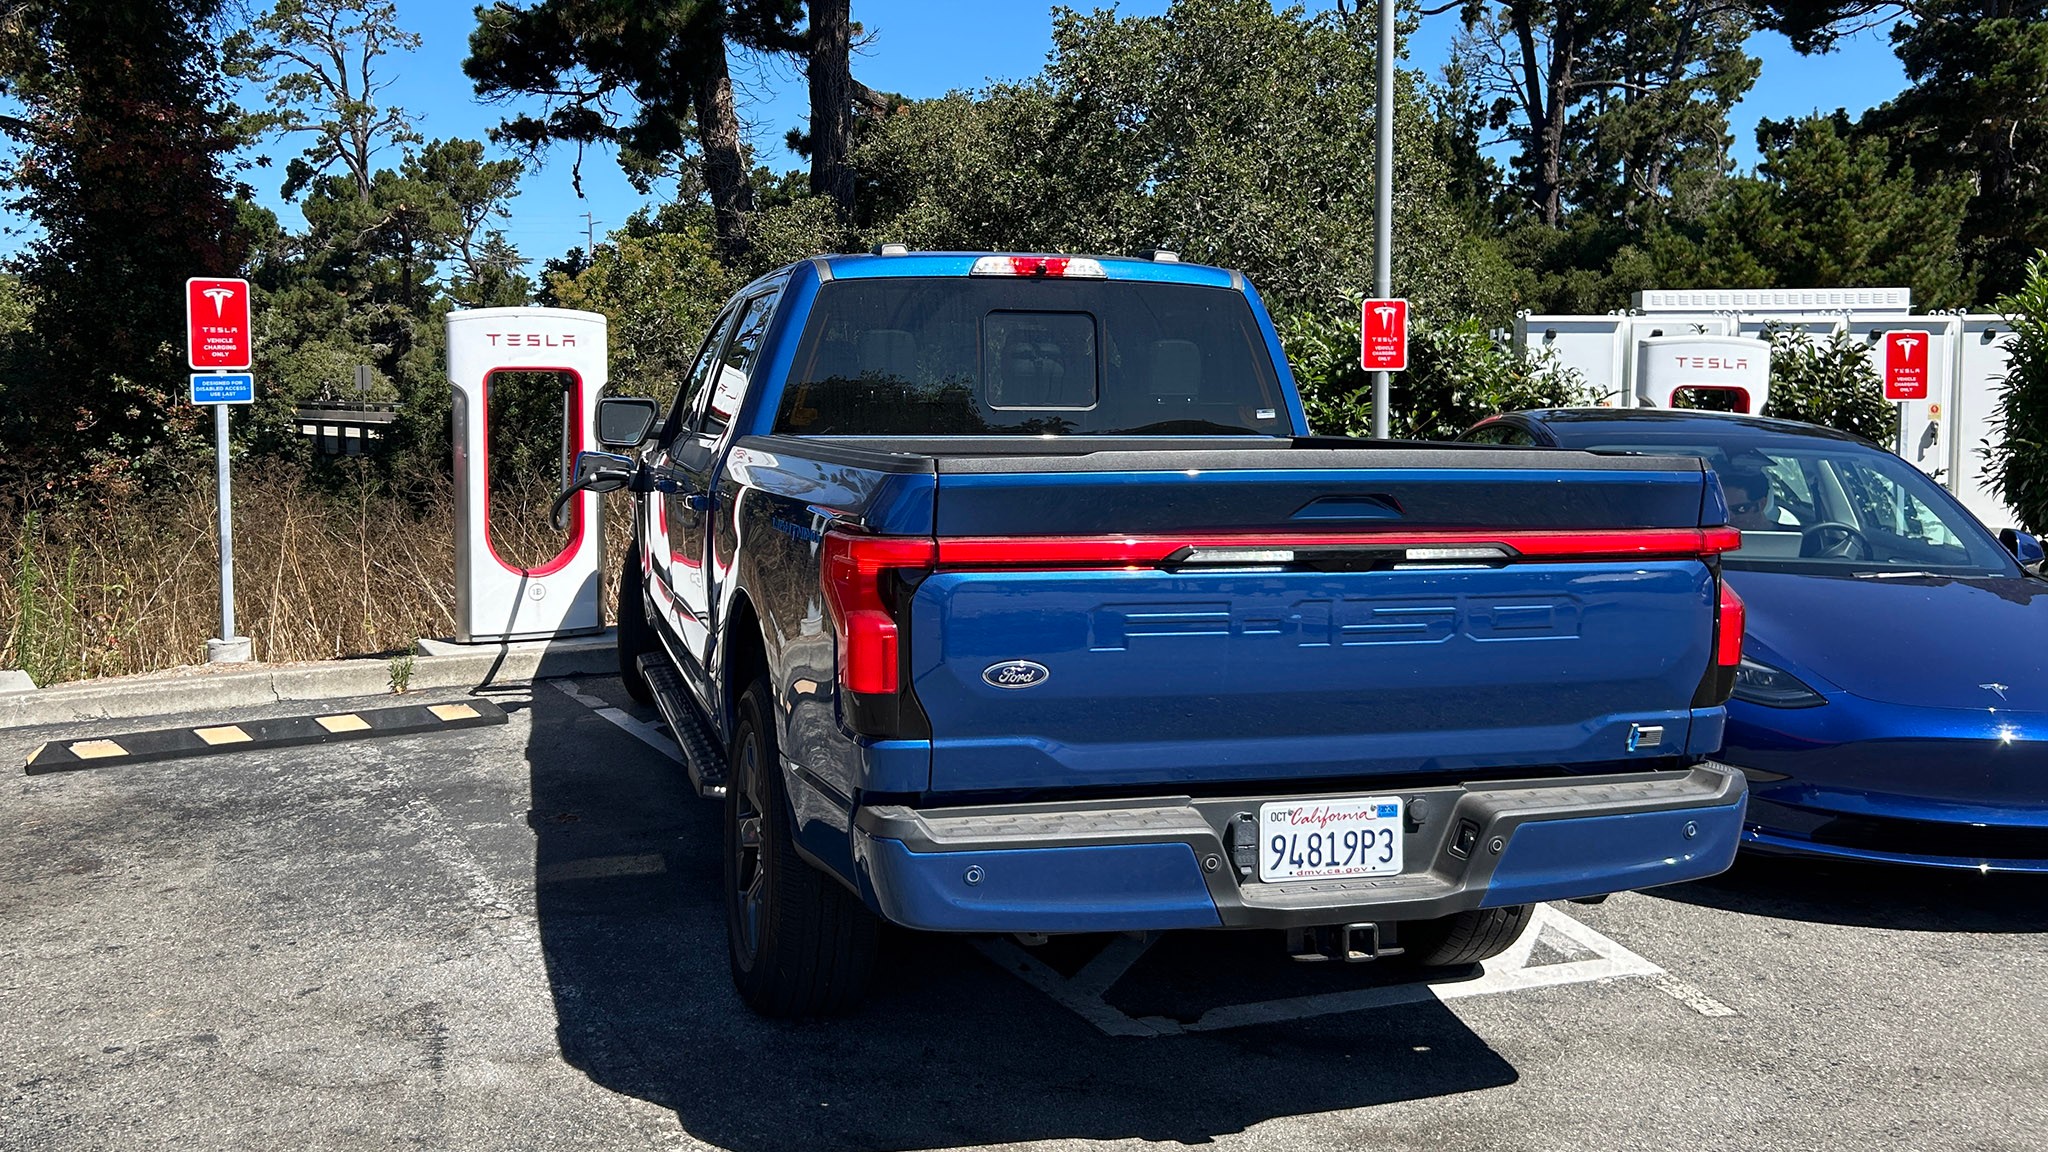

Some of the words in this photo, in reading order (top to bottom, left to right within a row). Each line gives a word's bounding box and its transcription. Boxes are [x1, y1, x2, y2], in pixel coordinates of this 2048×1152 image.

[486, 333, 576, 347] TESLA
[1675, 357, 1748, 370] TESLA
[1087, 594, 1583, 652] F-150
[998, 666, 1035, 683] Ford
[1270, 811, 1287, 822] OCT
[1290, 806, 1377, 829] California
[1270, 828, 1394, 871] 94819P3
[1296, 866, 1368, 877] dmv.ca.gov
